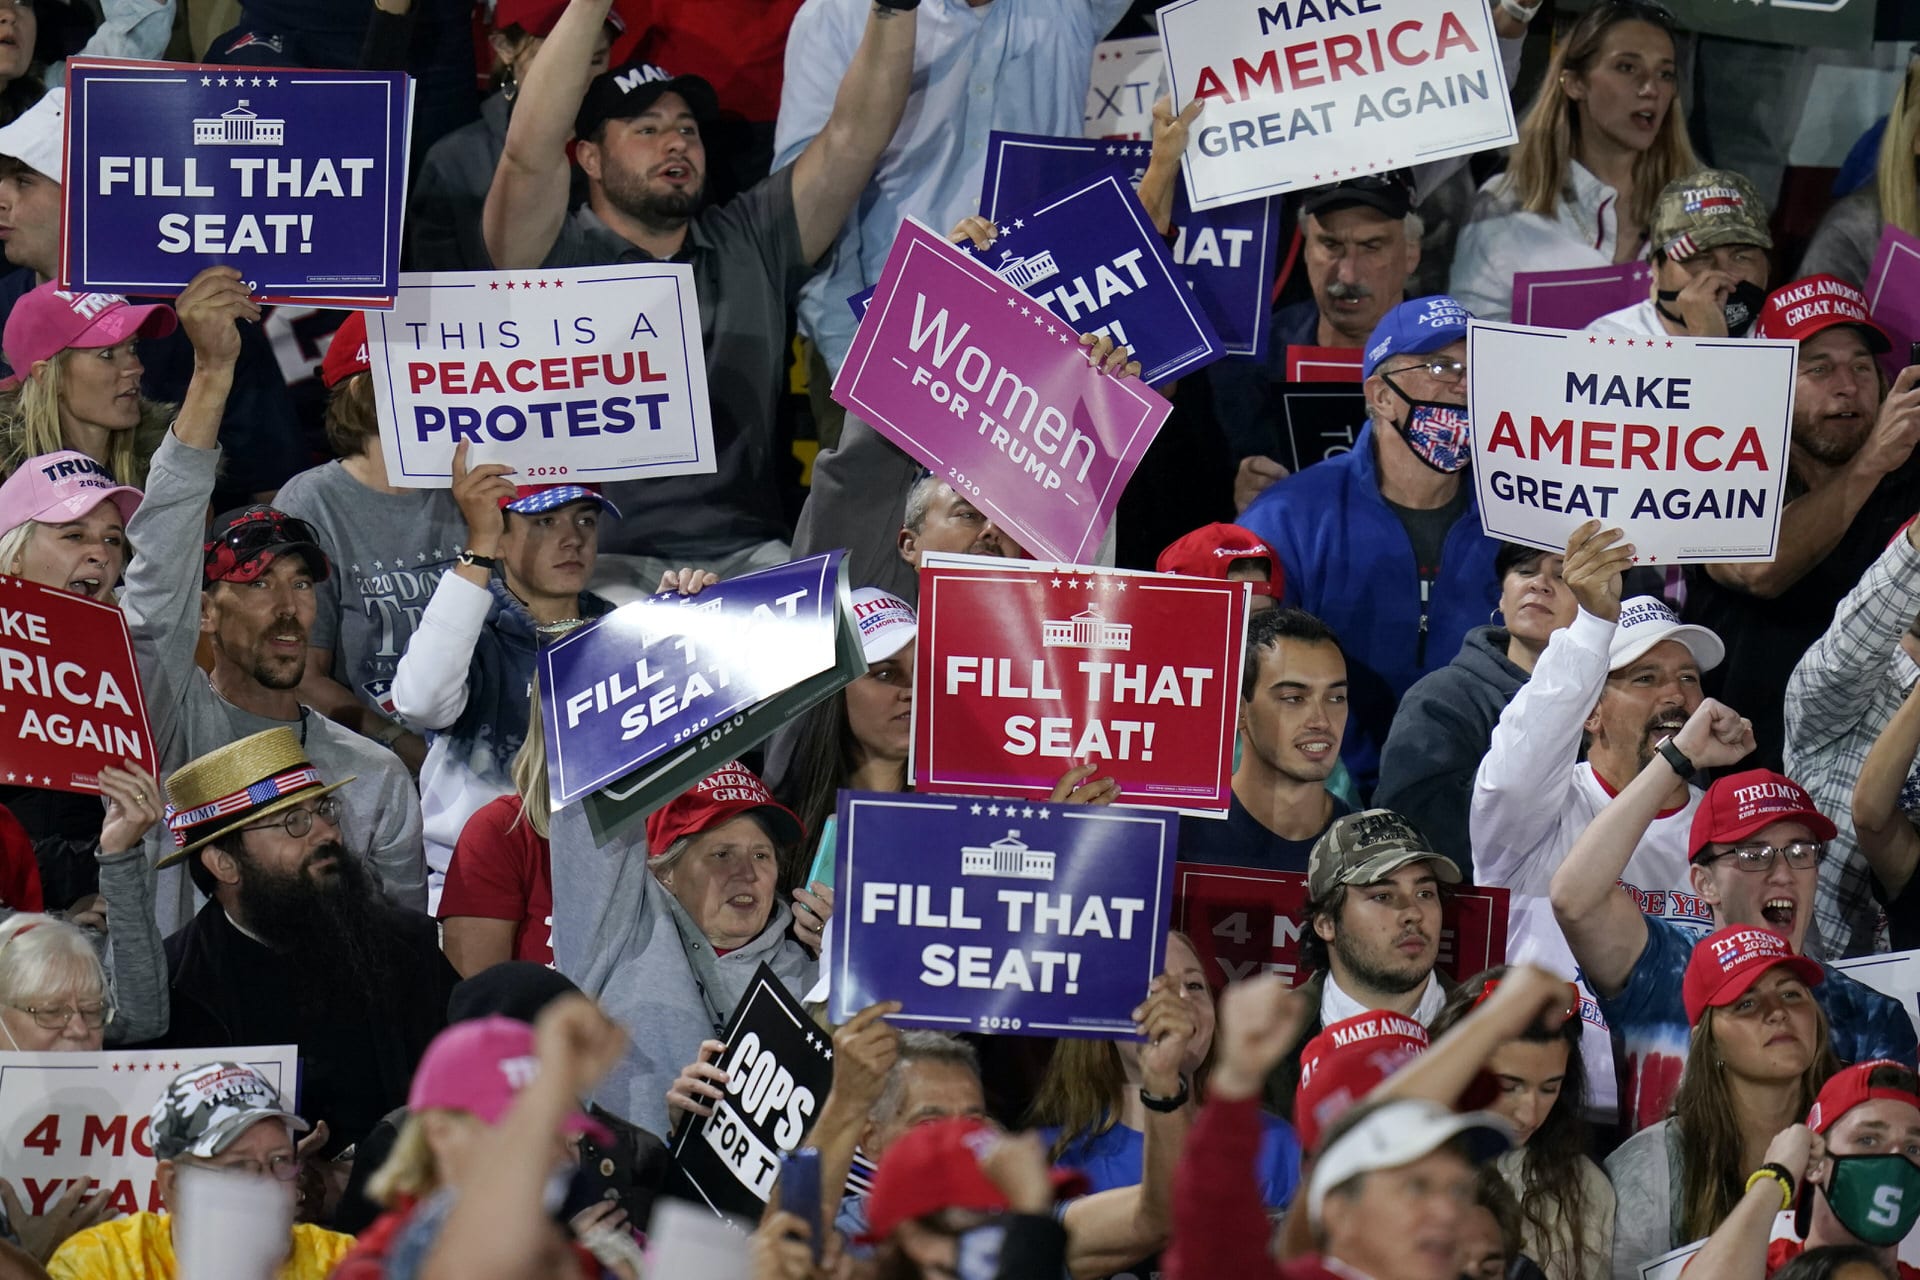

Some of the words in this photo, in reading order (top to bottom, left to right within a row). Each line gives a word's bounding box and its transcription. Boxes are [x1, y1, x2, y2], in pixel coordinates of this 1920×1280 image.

[1194, 11, 1480, 104] AMERICA
[1197, 100, 1336, 158] GREAT
[1353, 69, 1489, 128] AGAIN
[99, 156, 215, 197] FILL
[230, 157, 374, 198] THAT
[157, 212, 314, 254] SEAT!
[1773, 282, 1816, 311] MAKE
[1785, 299, 1831, 327] GREAT
[405, 320, 520, 350] THIS
[553, 316, 596, 346] IS
[630, 312, 658, 340] A
[408, 351, 667, 394] PEACEFUL
[908, 292, 1096, 483] Women
[1566, 371, 1691, 409] MAKE
[413, 393, 670, 444] PROTEST
[911, 365, 970, 420] FOR
[977, 411, 1062, 490] TRUMP
[1487, 410, 1769, 471] AMERICA
[527, 465, 568, 477] 2020
[948, 467, 981, 496] 2020
[1490, 470, 1618, 519] GREAT
[1630, 488, 1766, 519] AGAIN
[356, 573, 394, 595] 2020
[1617, 604, 1646, 620] AKE
[1622, 612, 1660, 629] GREAT
[566, 658, 665, 730] FILL
[946, 655, 1062, 700] FILL
[1078, 661, 1214, 707] THAT
[18, 709, 143, 760] AGAIN
[673, 718, 709, 744] 2020
[699, 713, 745, 750] 2020
[1003, 715, 1156, 762] SEAT!
[1734, 782, 1801, 805] TRUMP
[862, 882, 982, 930] FILL
[997, 890, 1145, 940] THAT
[1212, 912, 1252, 944] 4
[1711, 930, 1785, 956] Trump
[1722, 960, 1734, 973] NO
[1735, 950, 1759, 965] MORE
[919, 943, 1082, 995] SEAT!
[979, 1016, 1022, 1031] 2020
[1332, 1020, 1379, 1049] MAKE
[725, 1031, 816, 1151] COPS
[23, 1114, 62, 1157] 4
[708, 1105, 750, 1168] FOR
[1867, 1184, 1904, 1227] S
